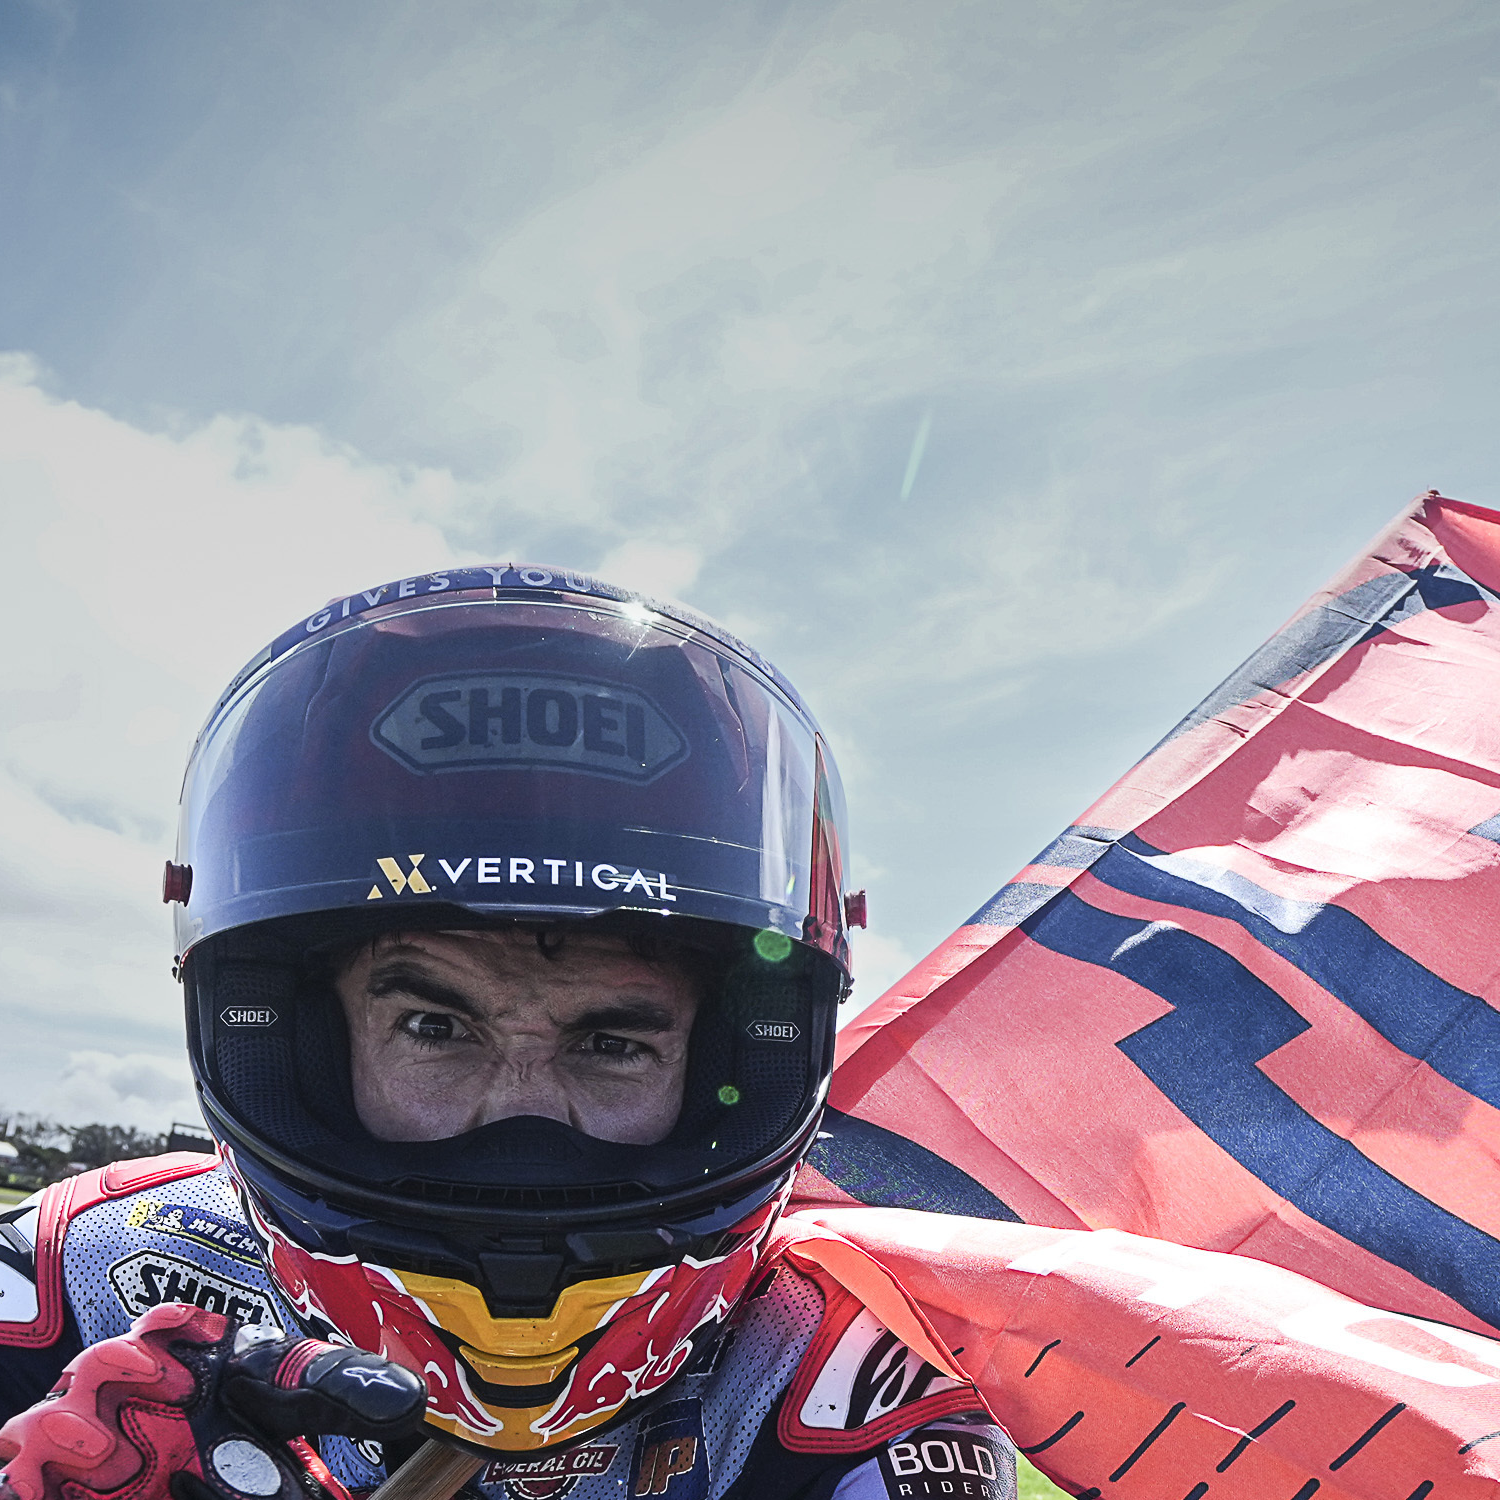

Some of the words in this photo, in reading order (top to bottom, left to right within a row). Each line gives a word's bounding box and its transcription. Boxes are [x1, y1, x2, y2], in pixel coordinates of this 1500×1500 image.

[305, 571, 450, 633] GIVES
[484, 567, 592, 592] YOU
[418, 686, 647, 766] SHOEI
[439, 857, 677, 902] VERTICAL
[227, 1009, 271, 1025] SHOEI
[754, 1023, 795, 1040] SHOEI
[572, 1450, 604, 1469] OIL
[888, 1440, 998, 1482] BOLD
